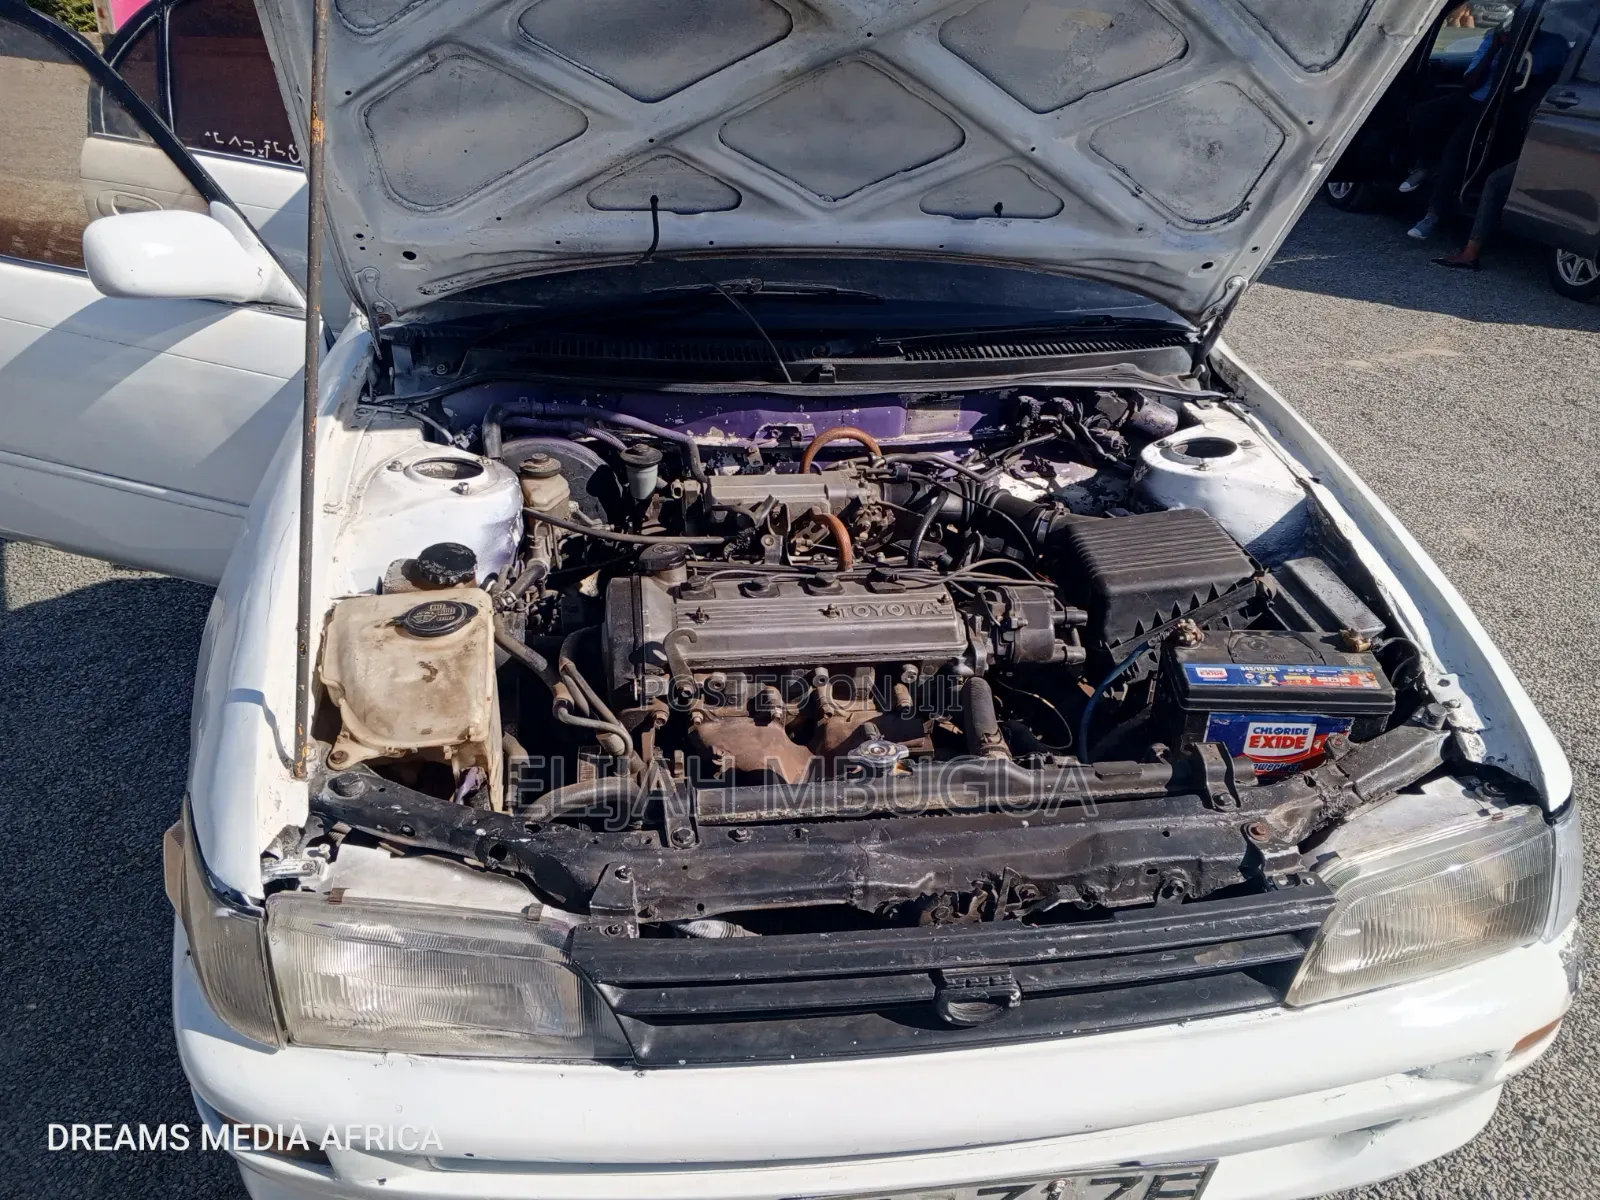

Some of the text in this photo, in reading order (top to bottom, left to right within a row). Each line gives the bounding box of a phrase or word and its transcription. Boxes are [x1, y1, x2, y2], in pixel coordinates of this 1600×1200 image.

[838, 603, 941, 618] TOYOTA
[1253, 726, 1309, 736] CHLORIDE
[1249, 735, 1307, 750] EXIDE
